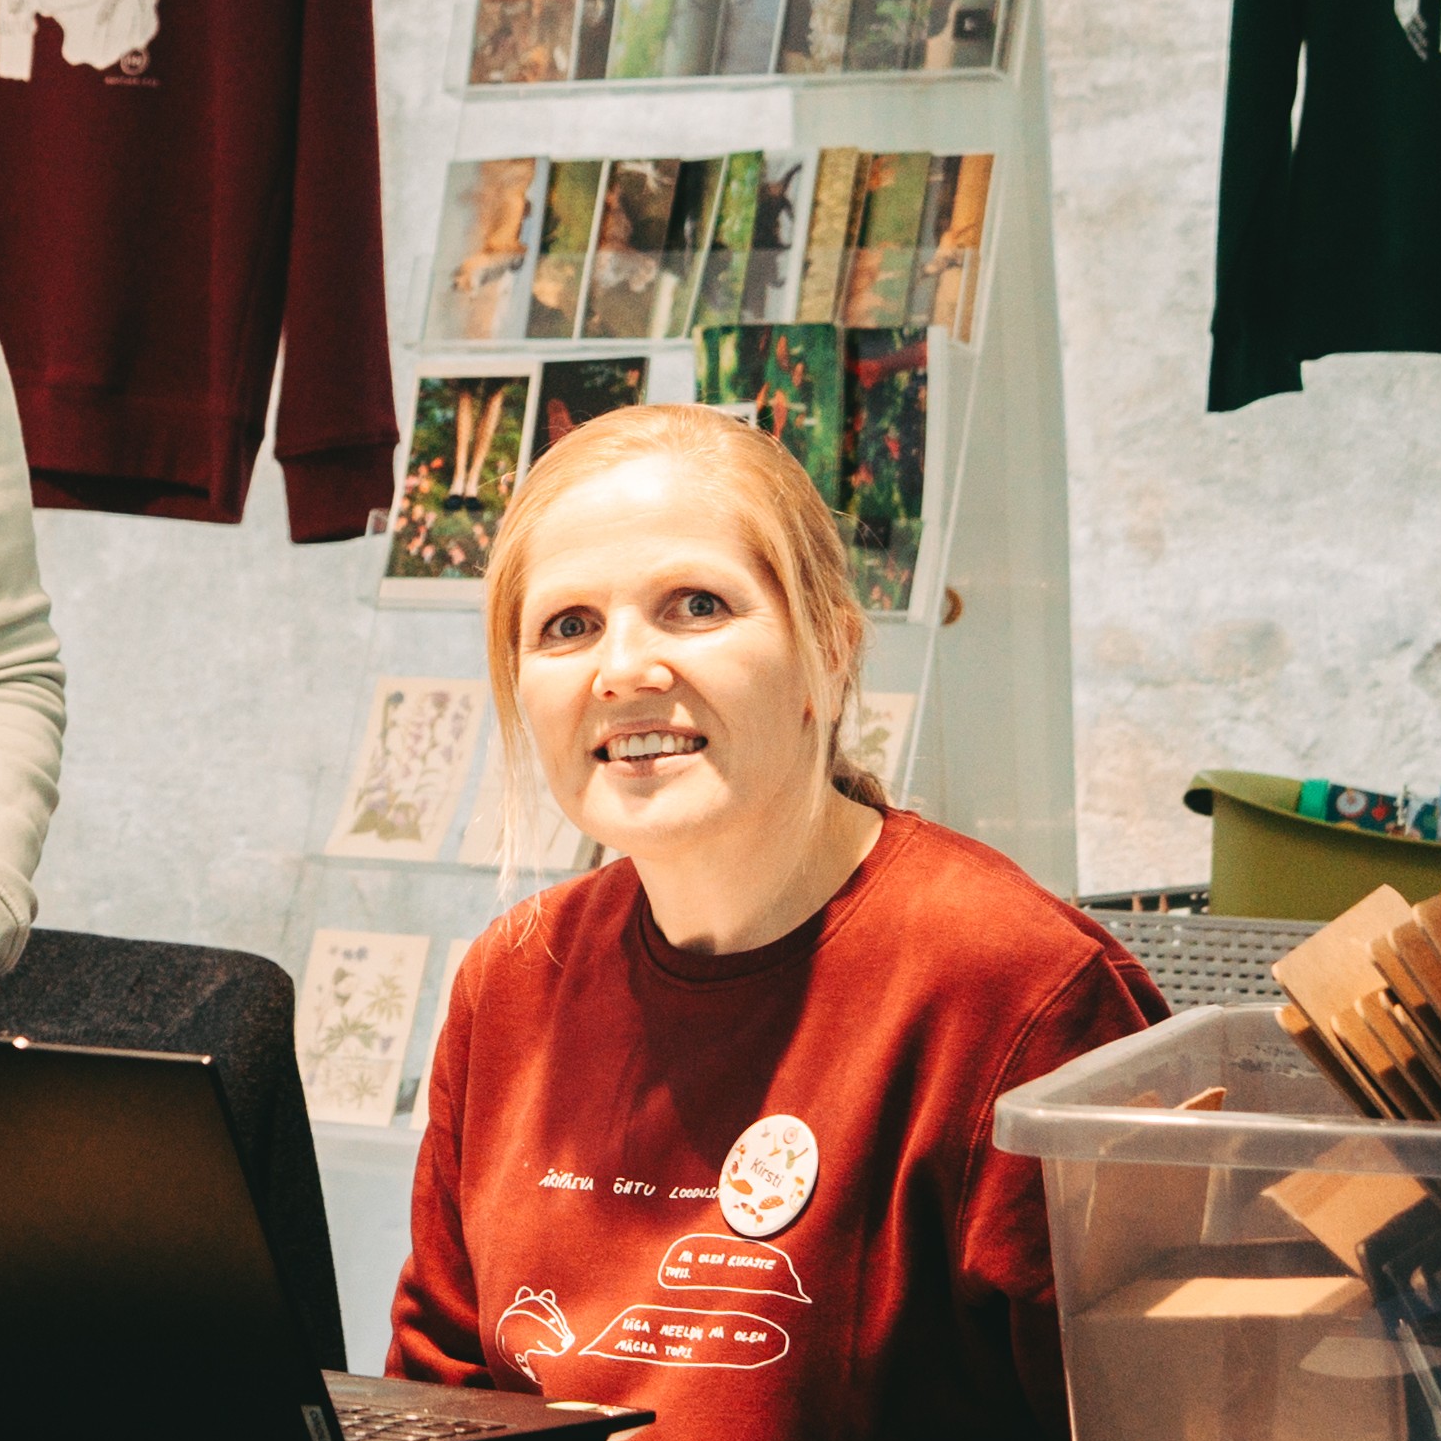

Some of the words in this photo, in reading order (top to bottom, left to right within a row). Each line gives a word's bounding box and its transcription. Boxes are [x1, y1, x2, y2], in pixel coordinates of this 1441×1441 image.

[538, 1168, 595, 1190] ÄRIPÄEVA
[749, 1158, 785, 1189] Kirsti
[677, 1250, 694, 1264] MA
[698, 1253, 725, 1265] OLEN
[727, 1255, 778, 1271] RIKASTE
[708, 1326, 725, 1339] MA
[733, 1331, 767, 1343] OLEN
[614, 1339, 657, 1355] MÄGRA
